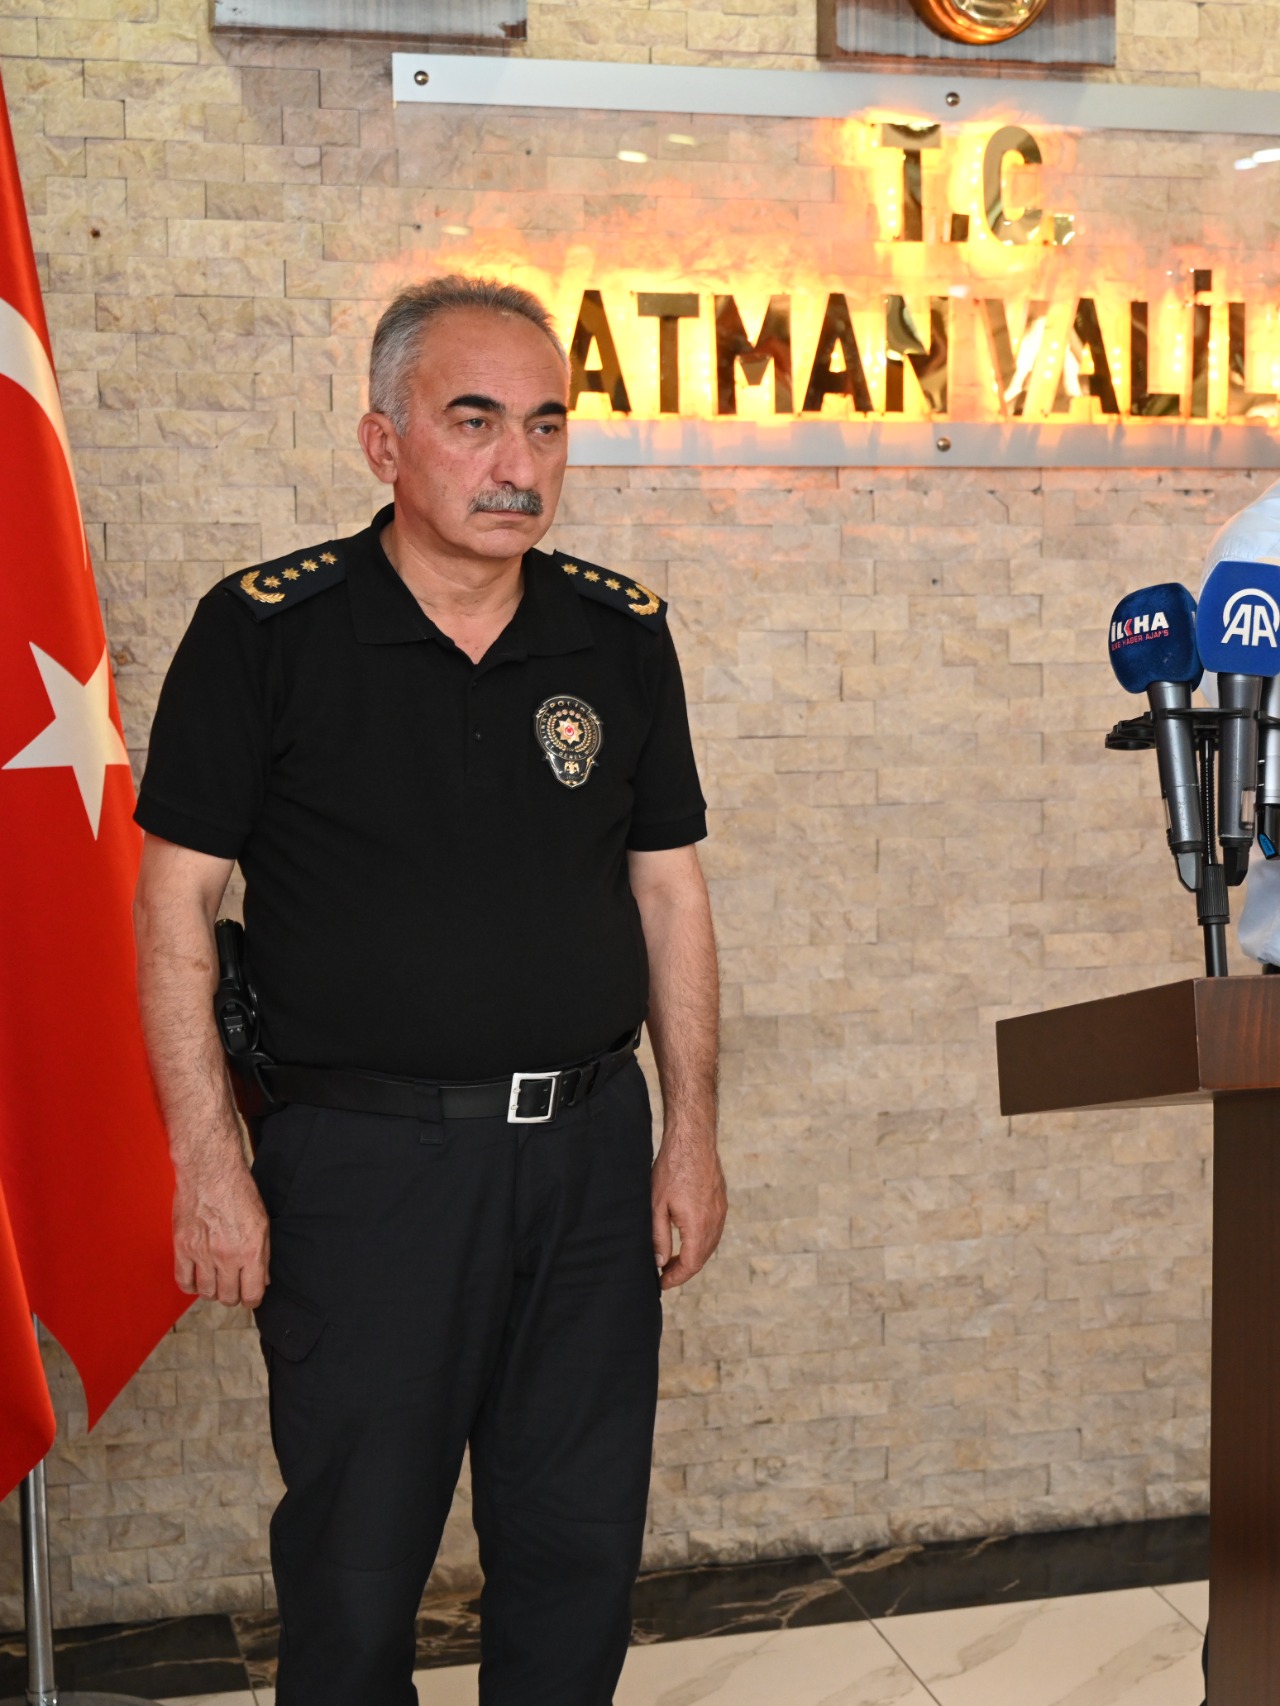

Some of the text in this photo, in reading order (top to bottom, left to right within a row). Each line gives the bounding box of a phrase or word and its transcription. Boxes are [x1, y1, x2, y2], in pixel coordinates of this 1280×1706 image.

[877, 122, 1077, 246] T.C.
[567, 288, 950, 415] ATMAN
[1220, 602, 1279, 648] AA
